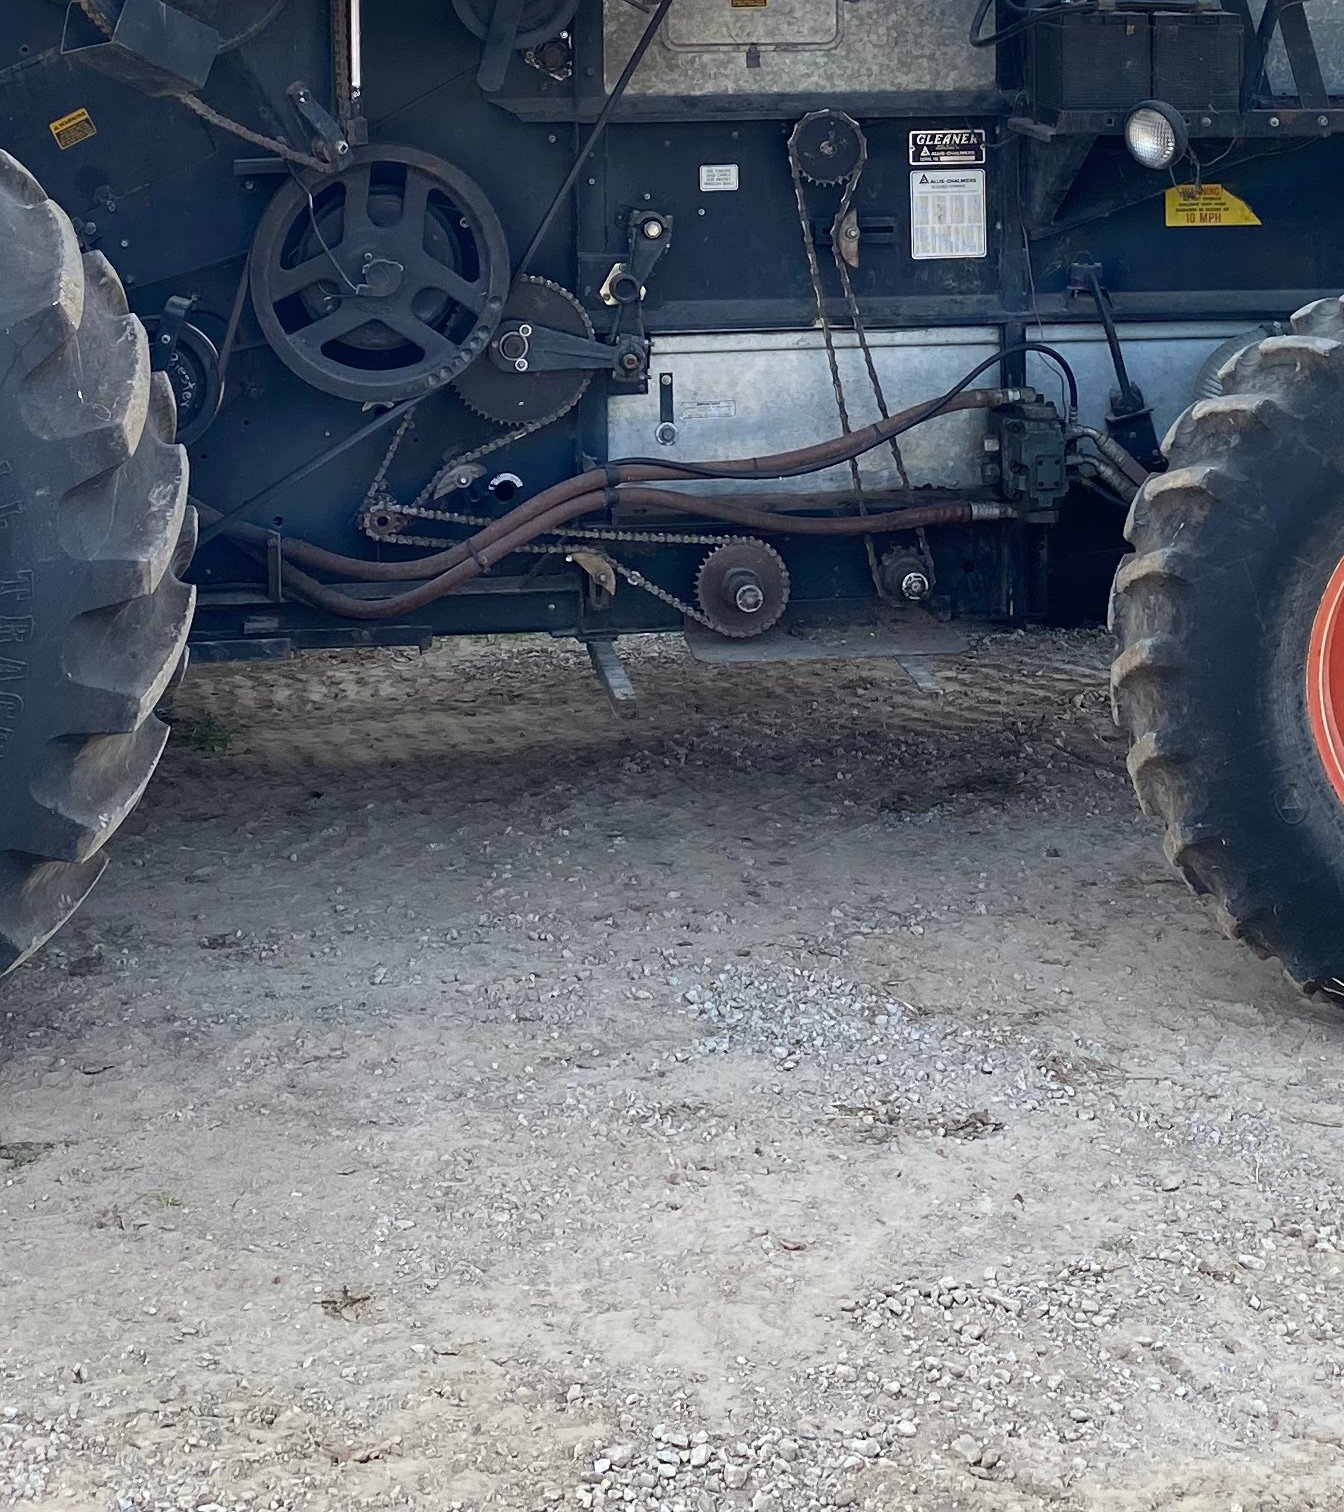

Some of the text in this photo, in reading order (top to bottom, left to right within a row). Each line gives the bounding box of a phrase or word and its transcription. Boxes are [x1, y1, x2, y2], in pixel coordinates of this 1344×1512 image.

[916, 133, 978, 145] GLEANER
[1185, 212, 1222, 224] 10 MPH
